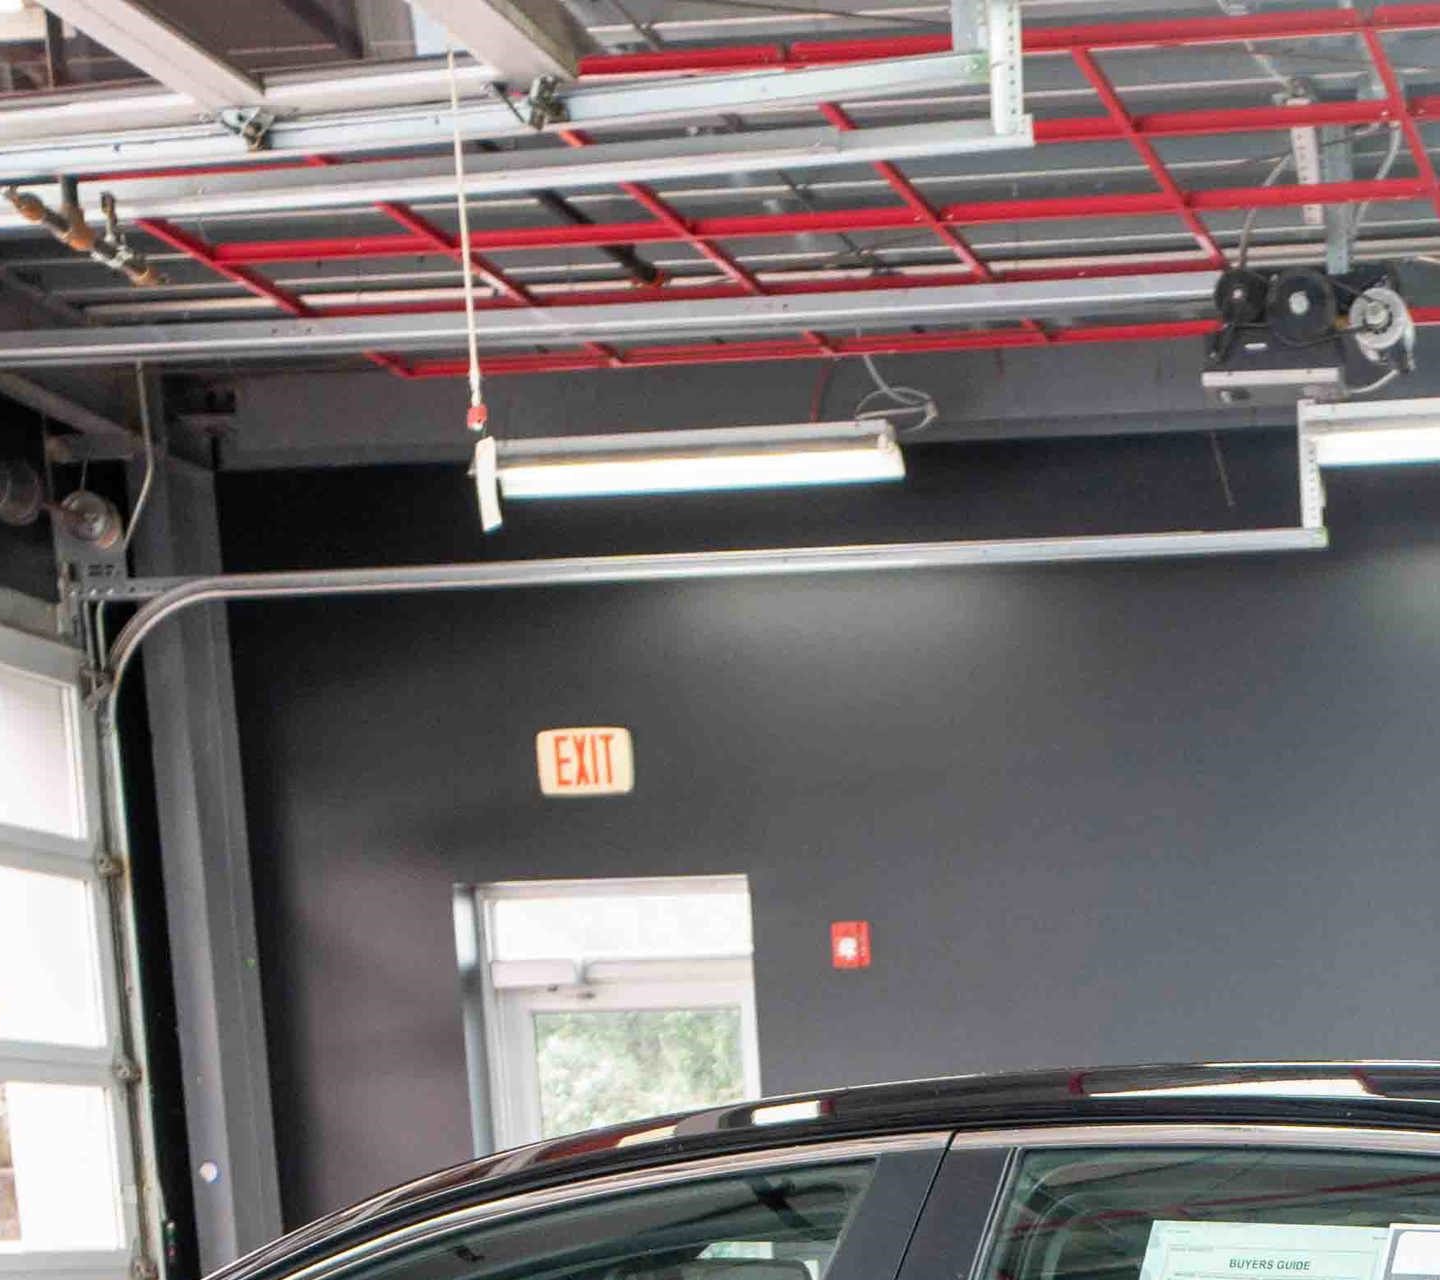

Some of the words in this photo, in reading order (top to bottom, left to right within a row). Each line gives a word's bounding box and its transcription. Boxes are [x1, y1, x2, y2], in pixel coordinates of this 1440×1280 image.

[553, 733, 614, 787] EXIT
[1228, 1258, 1274, 1270] BUYERS
[1276, 1259, 1311, 1271] GUIDE
